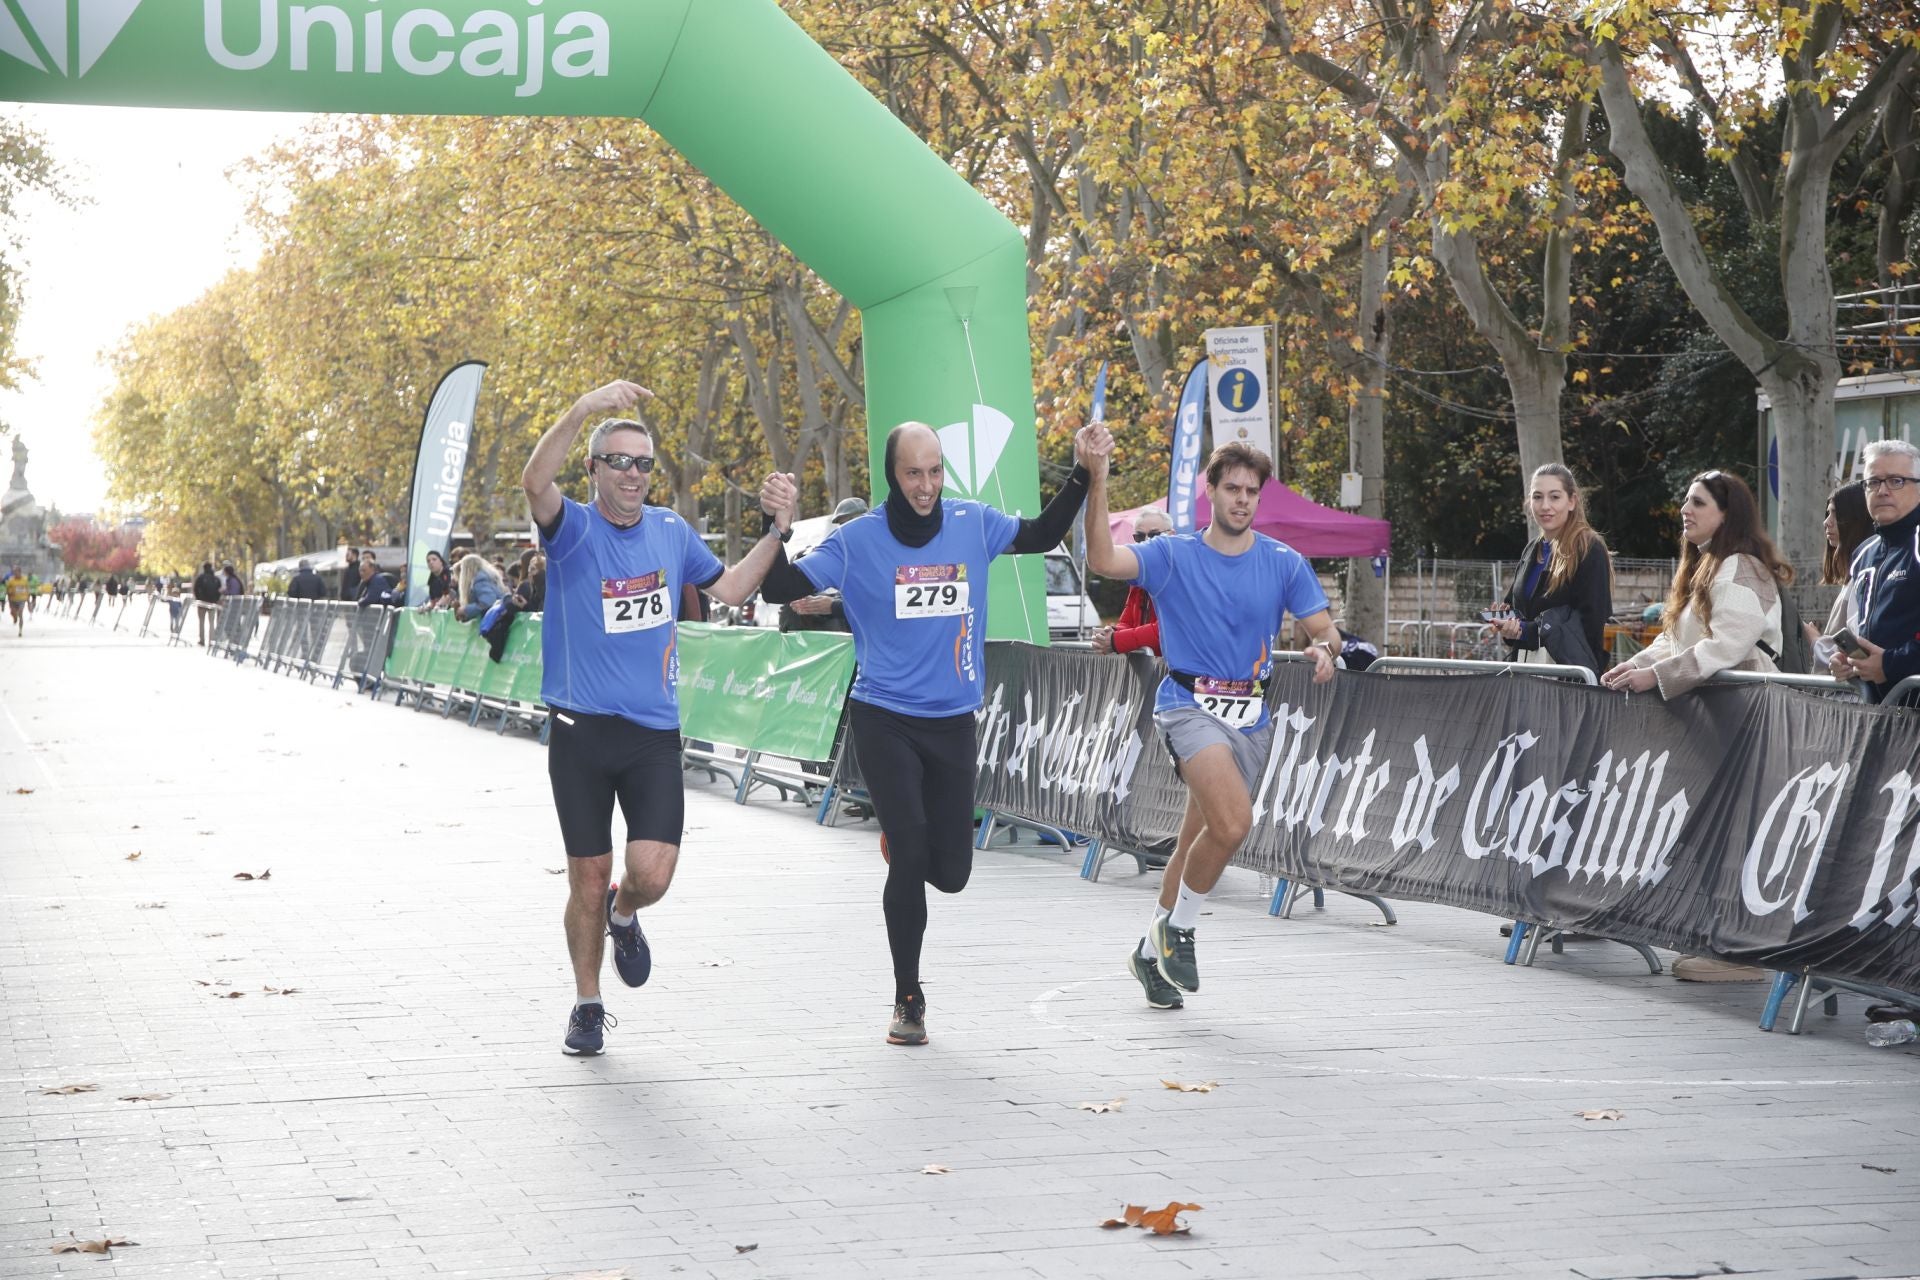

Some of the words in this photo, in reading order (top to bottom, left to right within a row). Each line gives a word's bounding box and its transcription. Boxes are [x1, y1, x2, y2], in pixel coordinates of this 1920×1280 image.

[203, 0, 611, 97] Unicaja
[1214, 337, 1238, 345] Oficina
[427, 420, 468, 537] Unicaja
[615, 593, 663, 622] 278
[906, 585, 958, 607] 279
[1204, 696, 1251, 719] 277
[1252, 702, 1390, 846] Norte
[1389, 734, 1460, 854] de
[1462, 730, 1691, 890] Castilla
